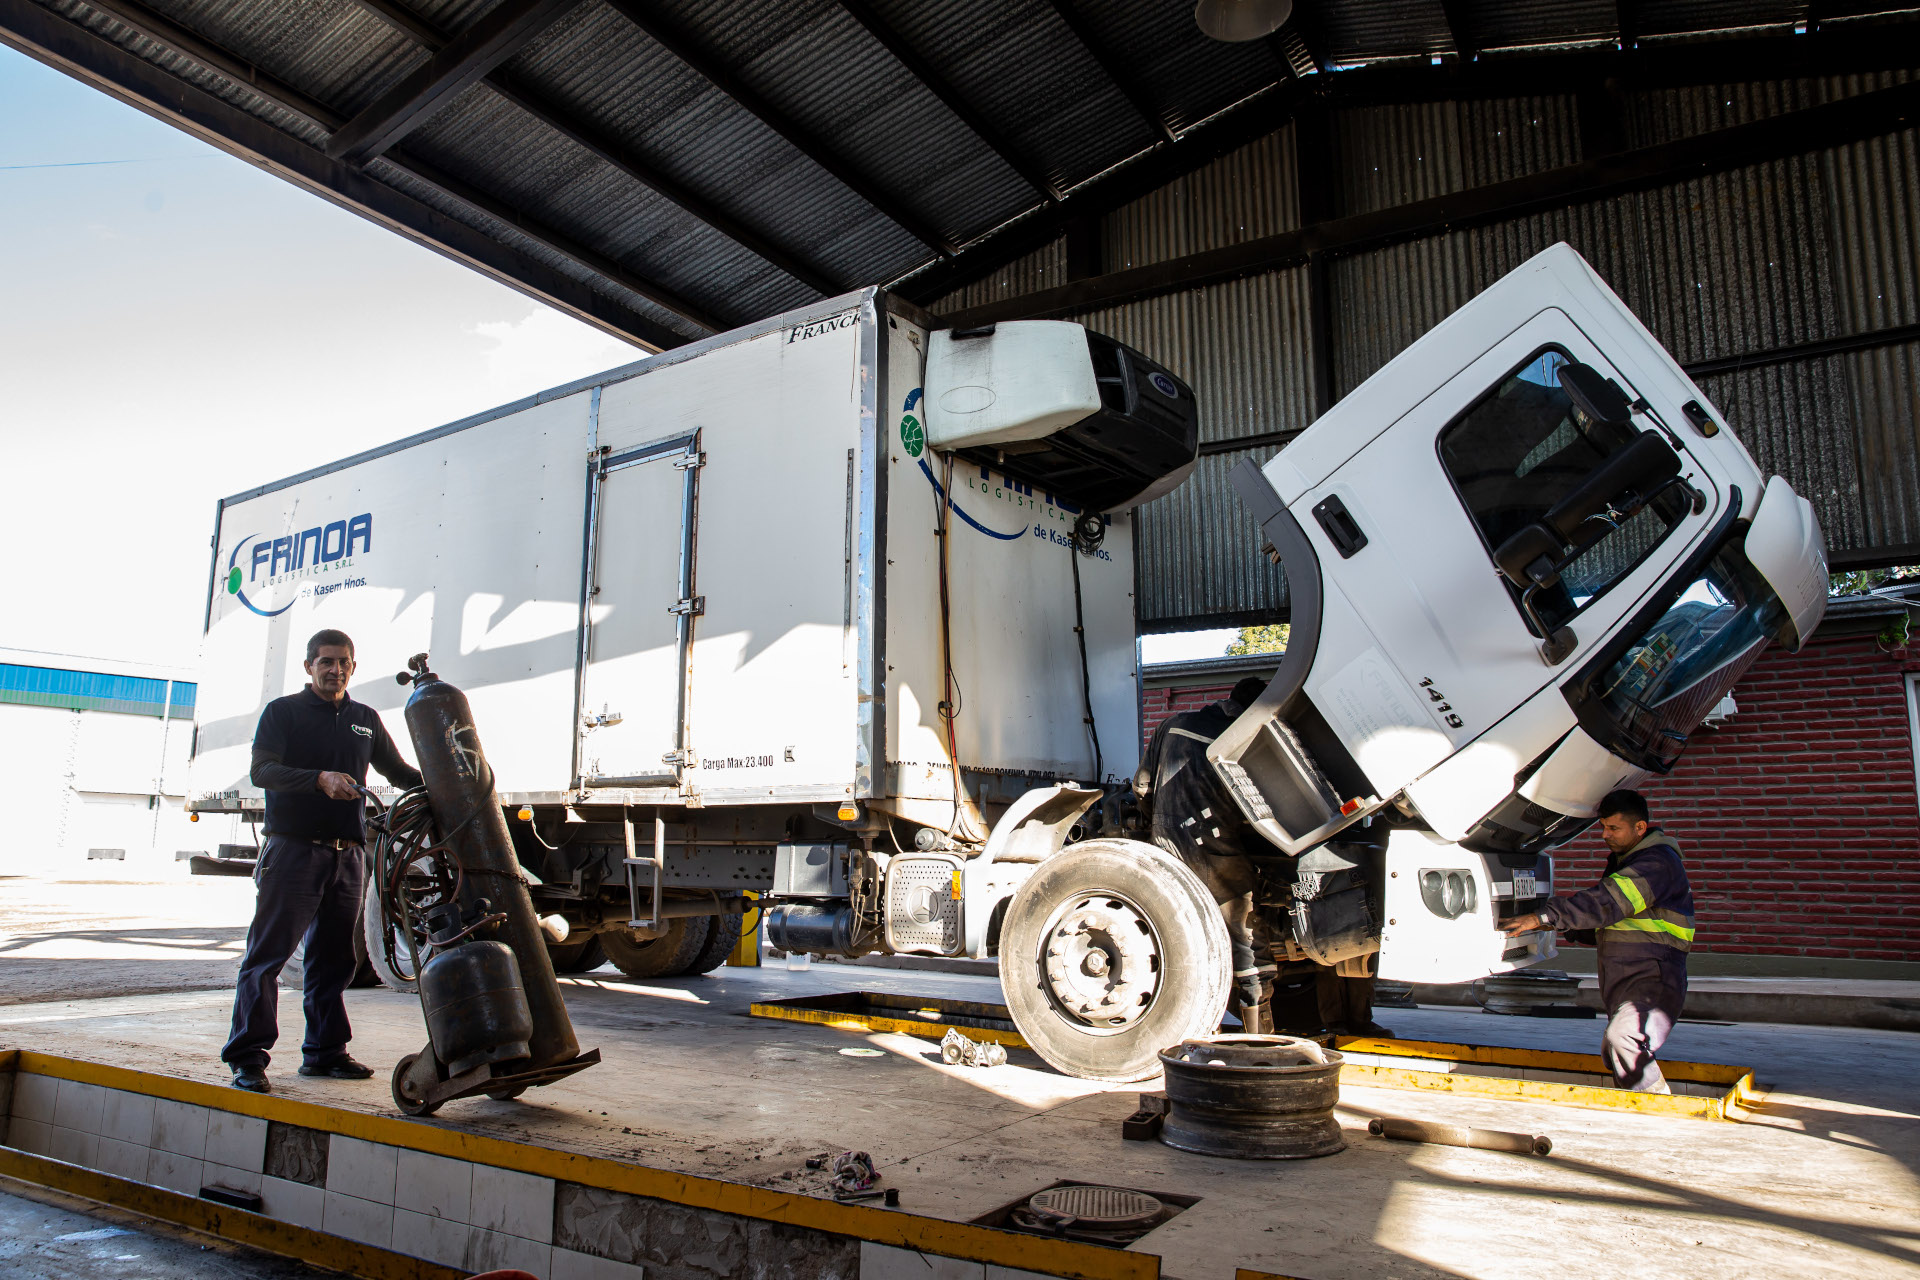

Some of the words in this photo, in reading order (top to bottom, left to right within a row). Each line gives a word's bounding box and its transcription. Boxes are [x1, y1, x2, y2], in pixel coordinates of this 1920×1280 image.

[969, 477, 1066, 523] LOGISTICA
[1033, 523, 1047, 540] de
[251, 513, 372, 582] FRINOA
[262, 564, 329, 588] LOGISTICA
[335, 558, 355, 570] S.R.L.
[301, 586, 312, 598] de
[314, 582, 342, 596] Kasem
[344, 576, 367, 590] Hnos.
[702, 758, 725, 770] Carga
